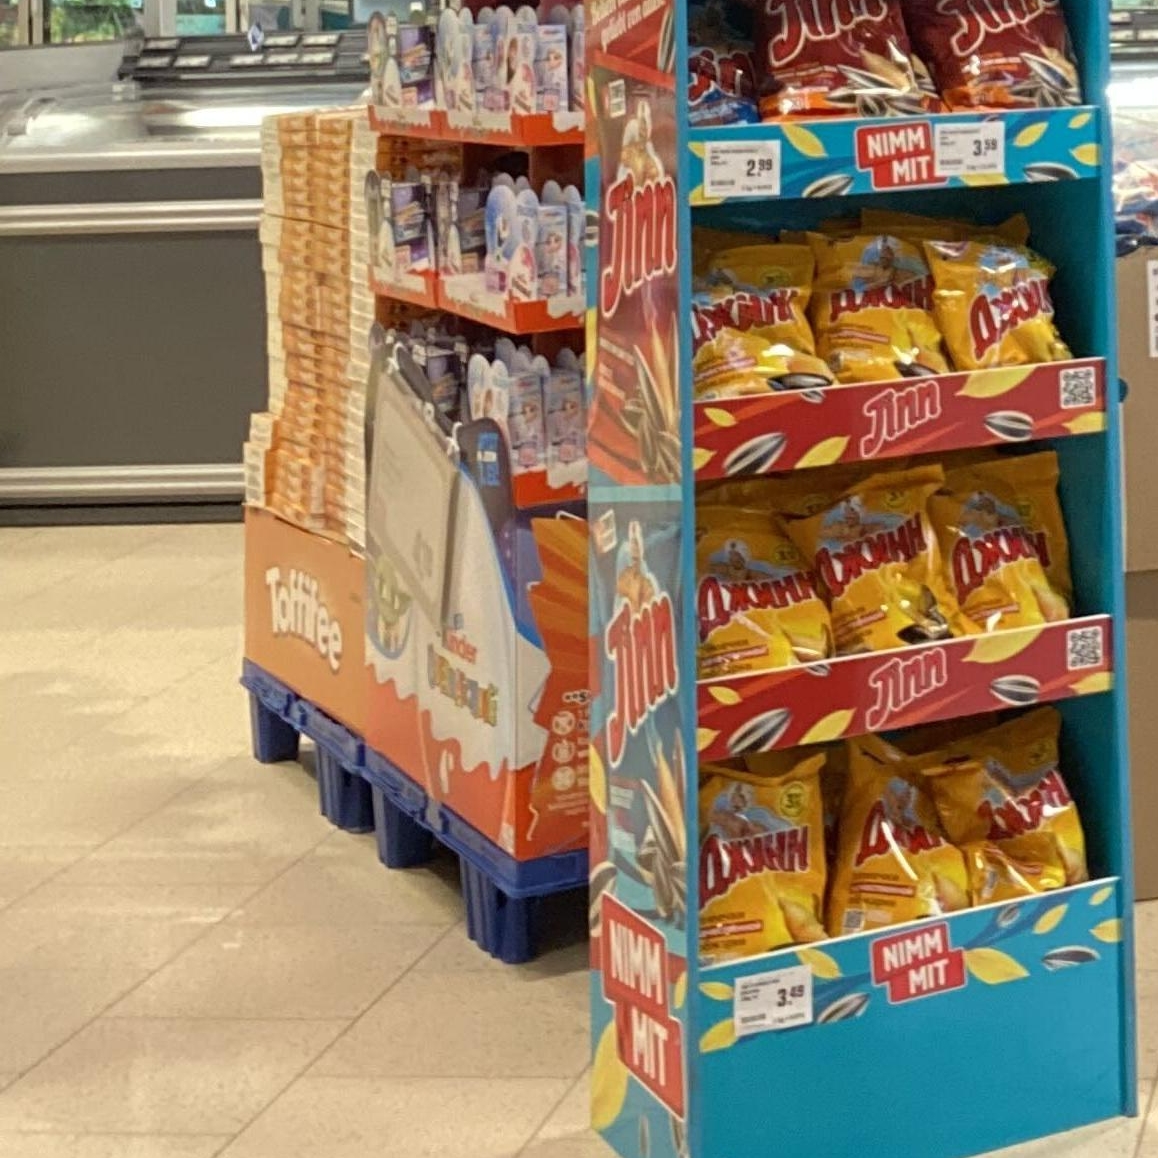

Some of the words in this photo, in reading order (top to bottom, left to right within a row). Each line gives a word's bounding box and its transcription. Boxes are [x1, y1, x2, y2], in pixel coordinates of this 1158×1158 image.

[867, 126, 926, 158] NIMM
[893, 156, 931, 184] MIT
[601, 168, 678, 319] Jinn
[860, 379, 941, 458] Jinn
[815, 511, 928, 599] ДЖИНН
[265, 566, 343, 671] Toffifee
[605, 592, 679, 768] Jinn
[865, 647, 948, 730] Jinn
[609, 919, 664, 1006] NIMM
[882, 929, 944, 973] NIMM
[908, 958, 950, 994] MIT
[631, 1005, 669, 1087] MIT
